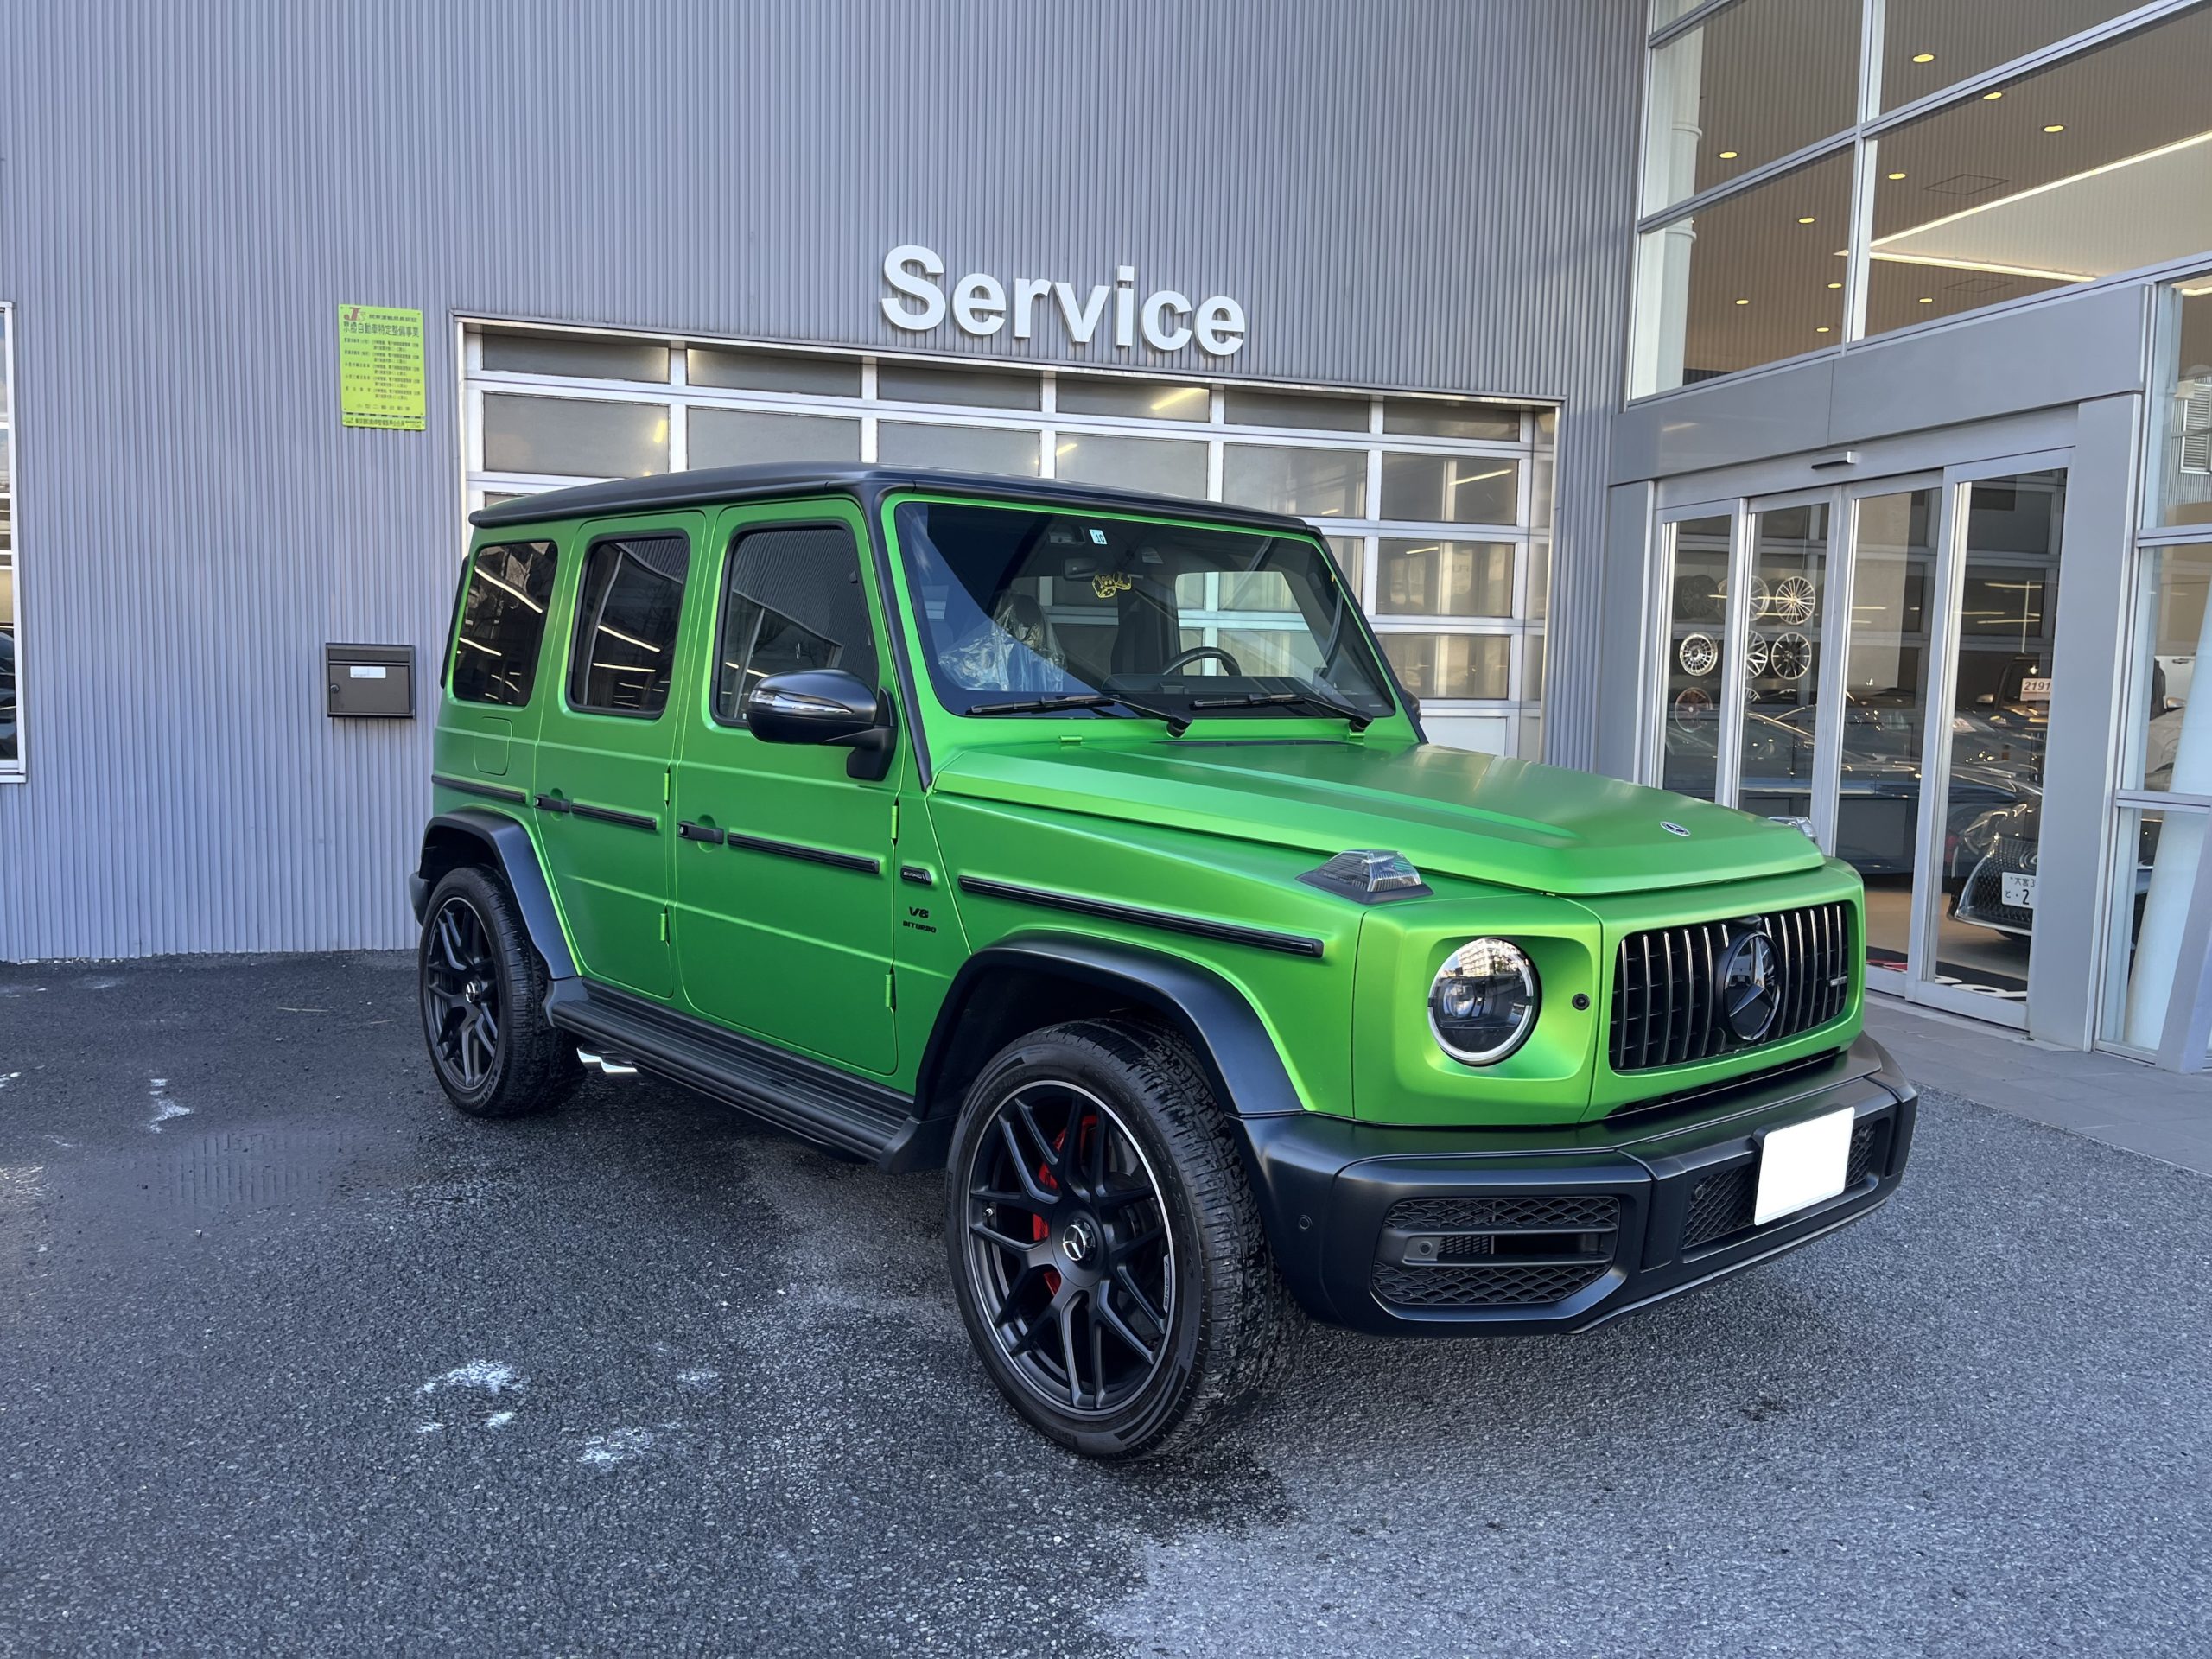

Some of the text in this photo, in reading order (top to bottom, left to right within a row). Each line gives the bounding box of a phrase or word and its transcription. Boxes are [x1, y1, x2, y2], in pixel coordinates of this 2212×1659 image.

[881, 245, 1245, 356] Service
[1096, 534, 1105, 543] 10
[909, 906, 929, 918] V8
[903, 921, 937, 933] BITURBO
